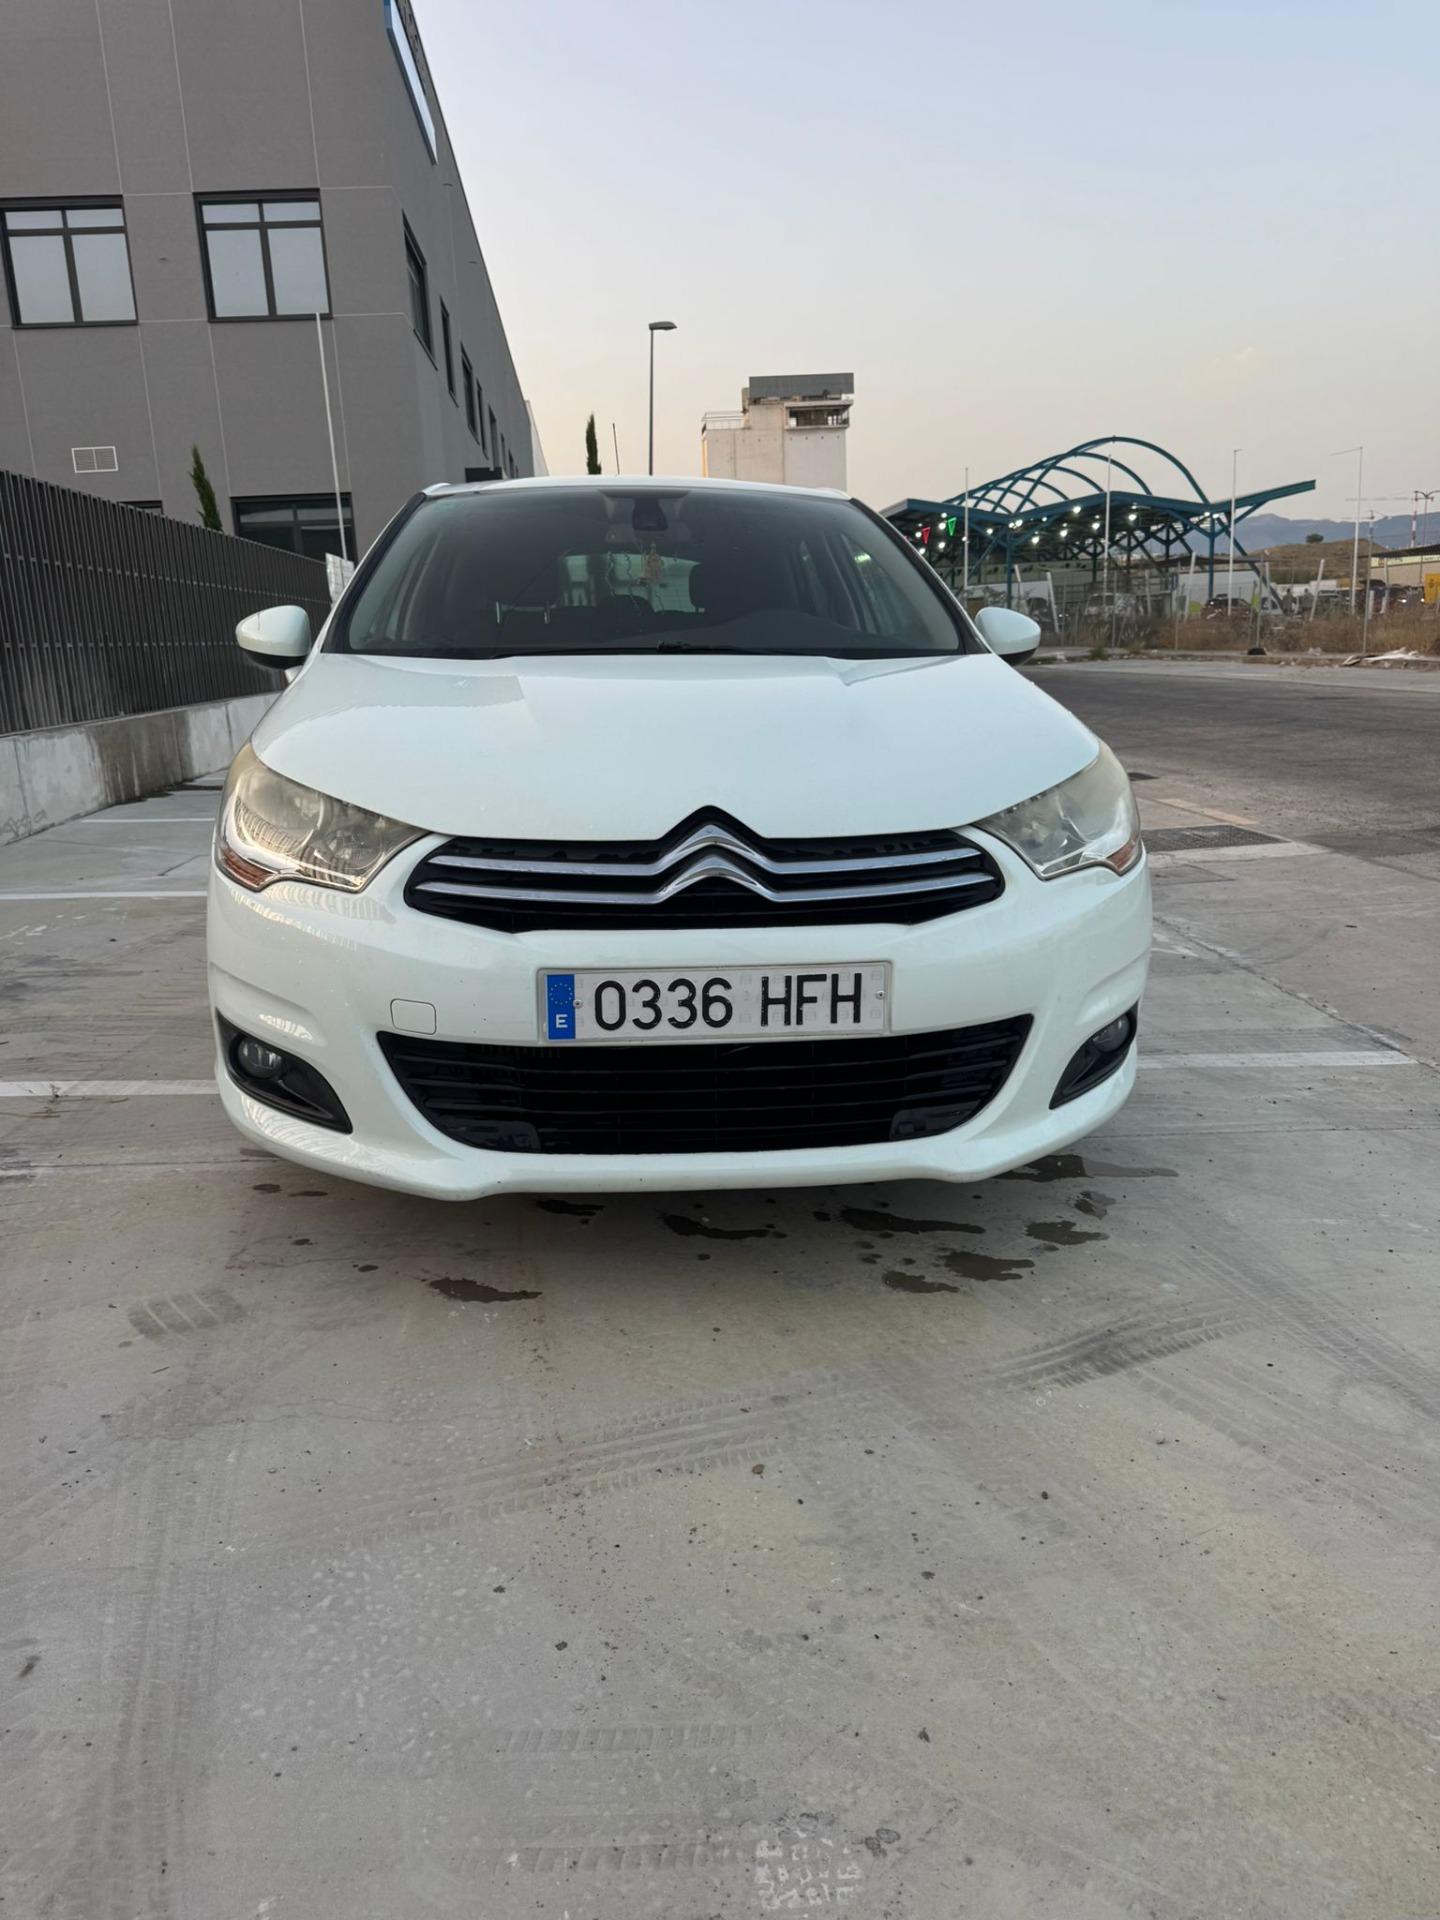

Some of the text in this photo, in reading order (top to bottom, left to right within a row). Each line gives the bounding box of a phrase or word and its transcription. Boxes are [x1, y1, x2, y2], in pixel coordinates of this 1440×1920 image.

[555, 972, 863, 1031] E 0336 HFH
